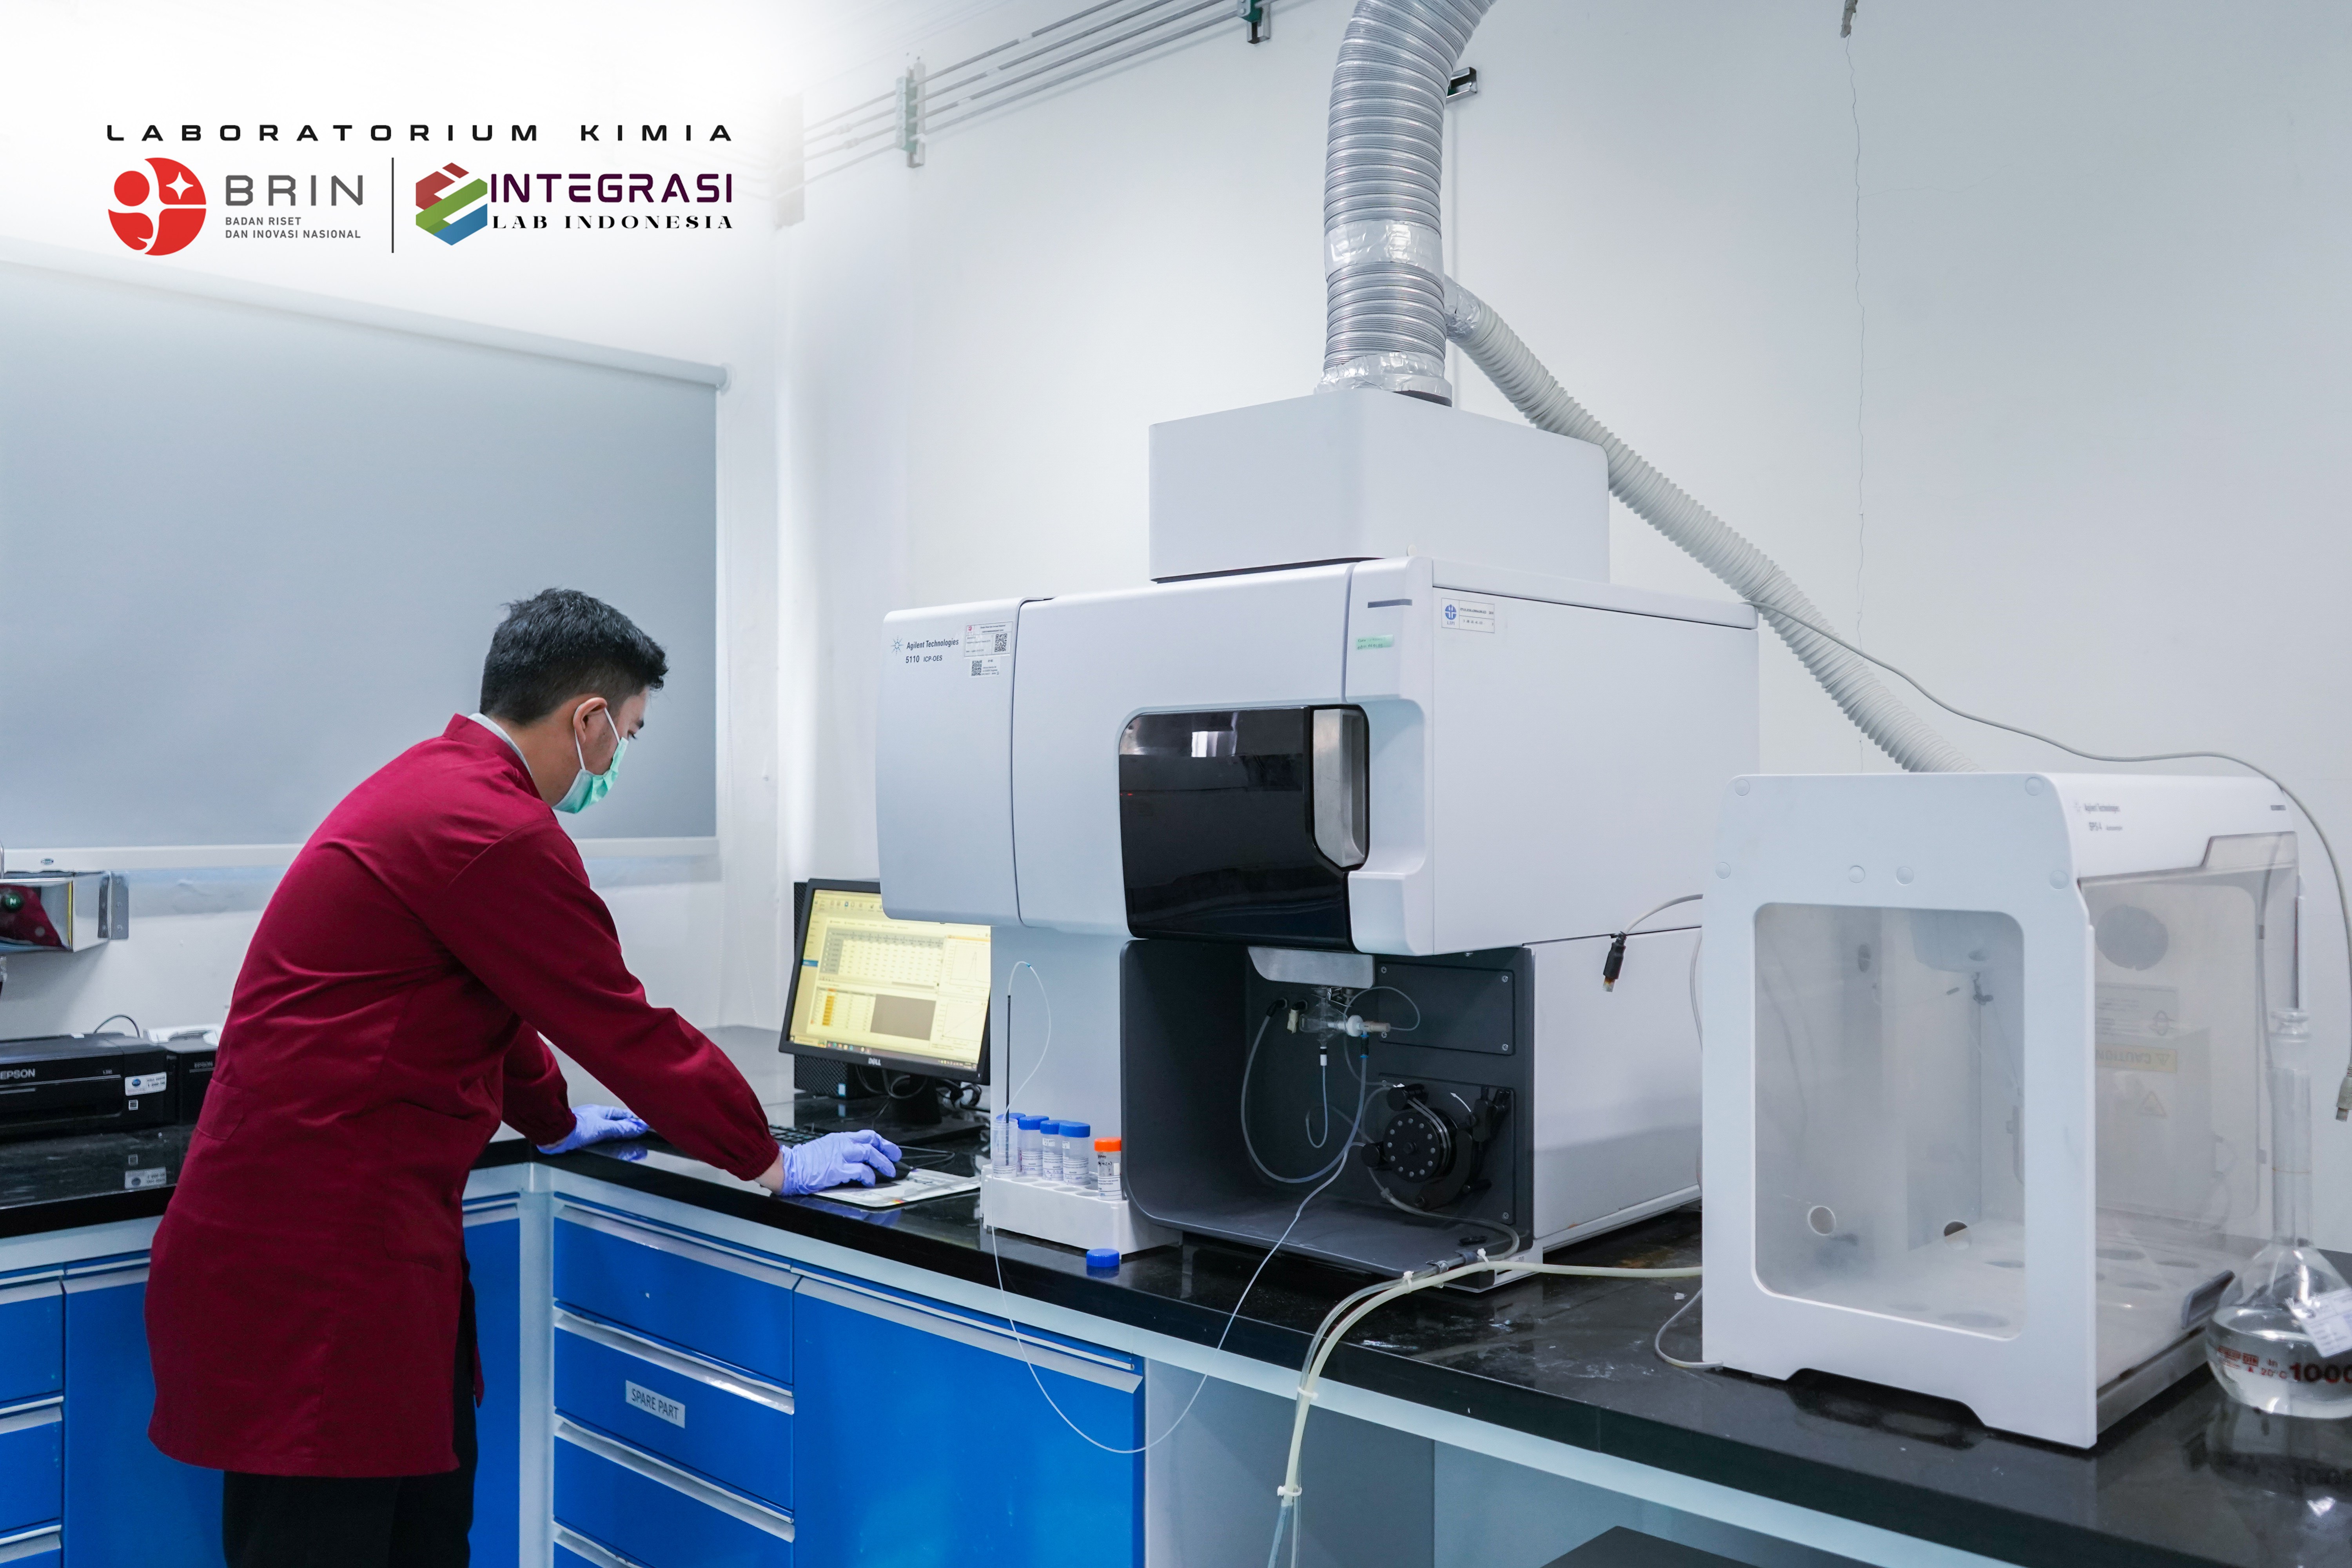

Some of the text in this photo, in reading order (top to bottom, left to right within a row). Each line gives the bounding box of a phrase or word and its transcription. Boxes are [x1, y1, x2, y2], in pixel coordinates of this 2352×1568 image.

[907, 641, 925, 651] Agilent
[926, 638, 959, 648] Technologies
[906, 655, 920, 663] 5110
[0, 1068, 36, 1080] EPSON
[632, 1388, 679, 1419] SPARE PART
